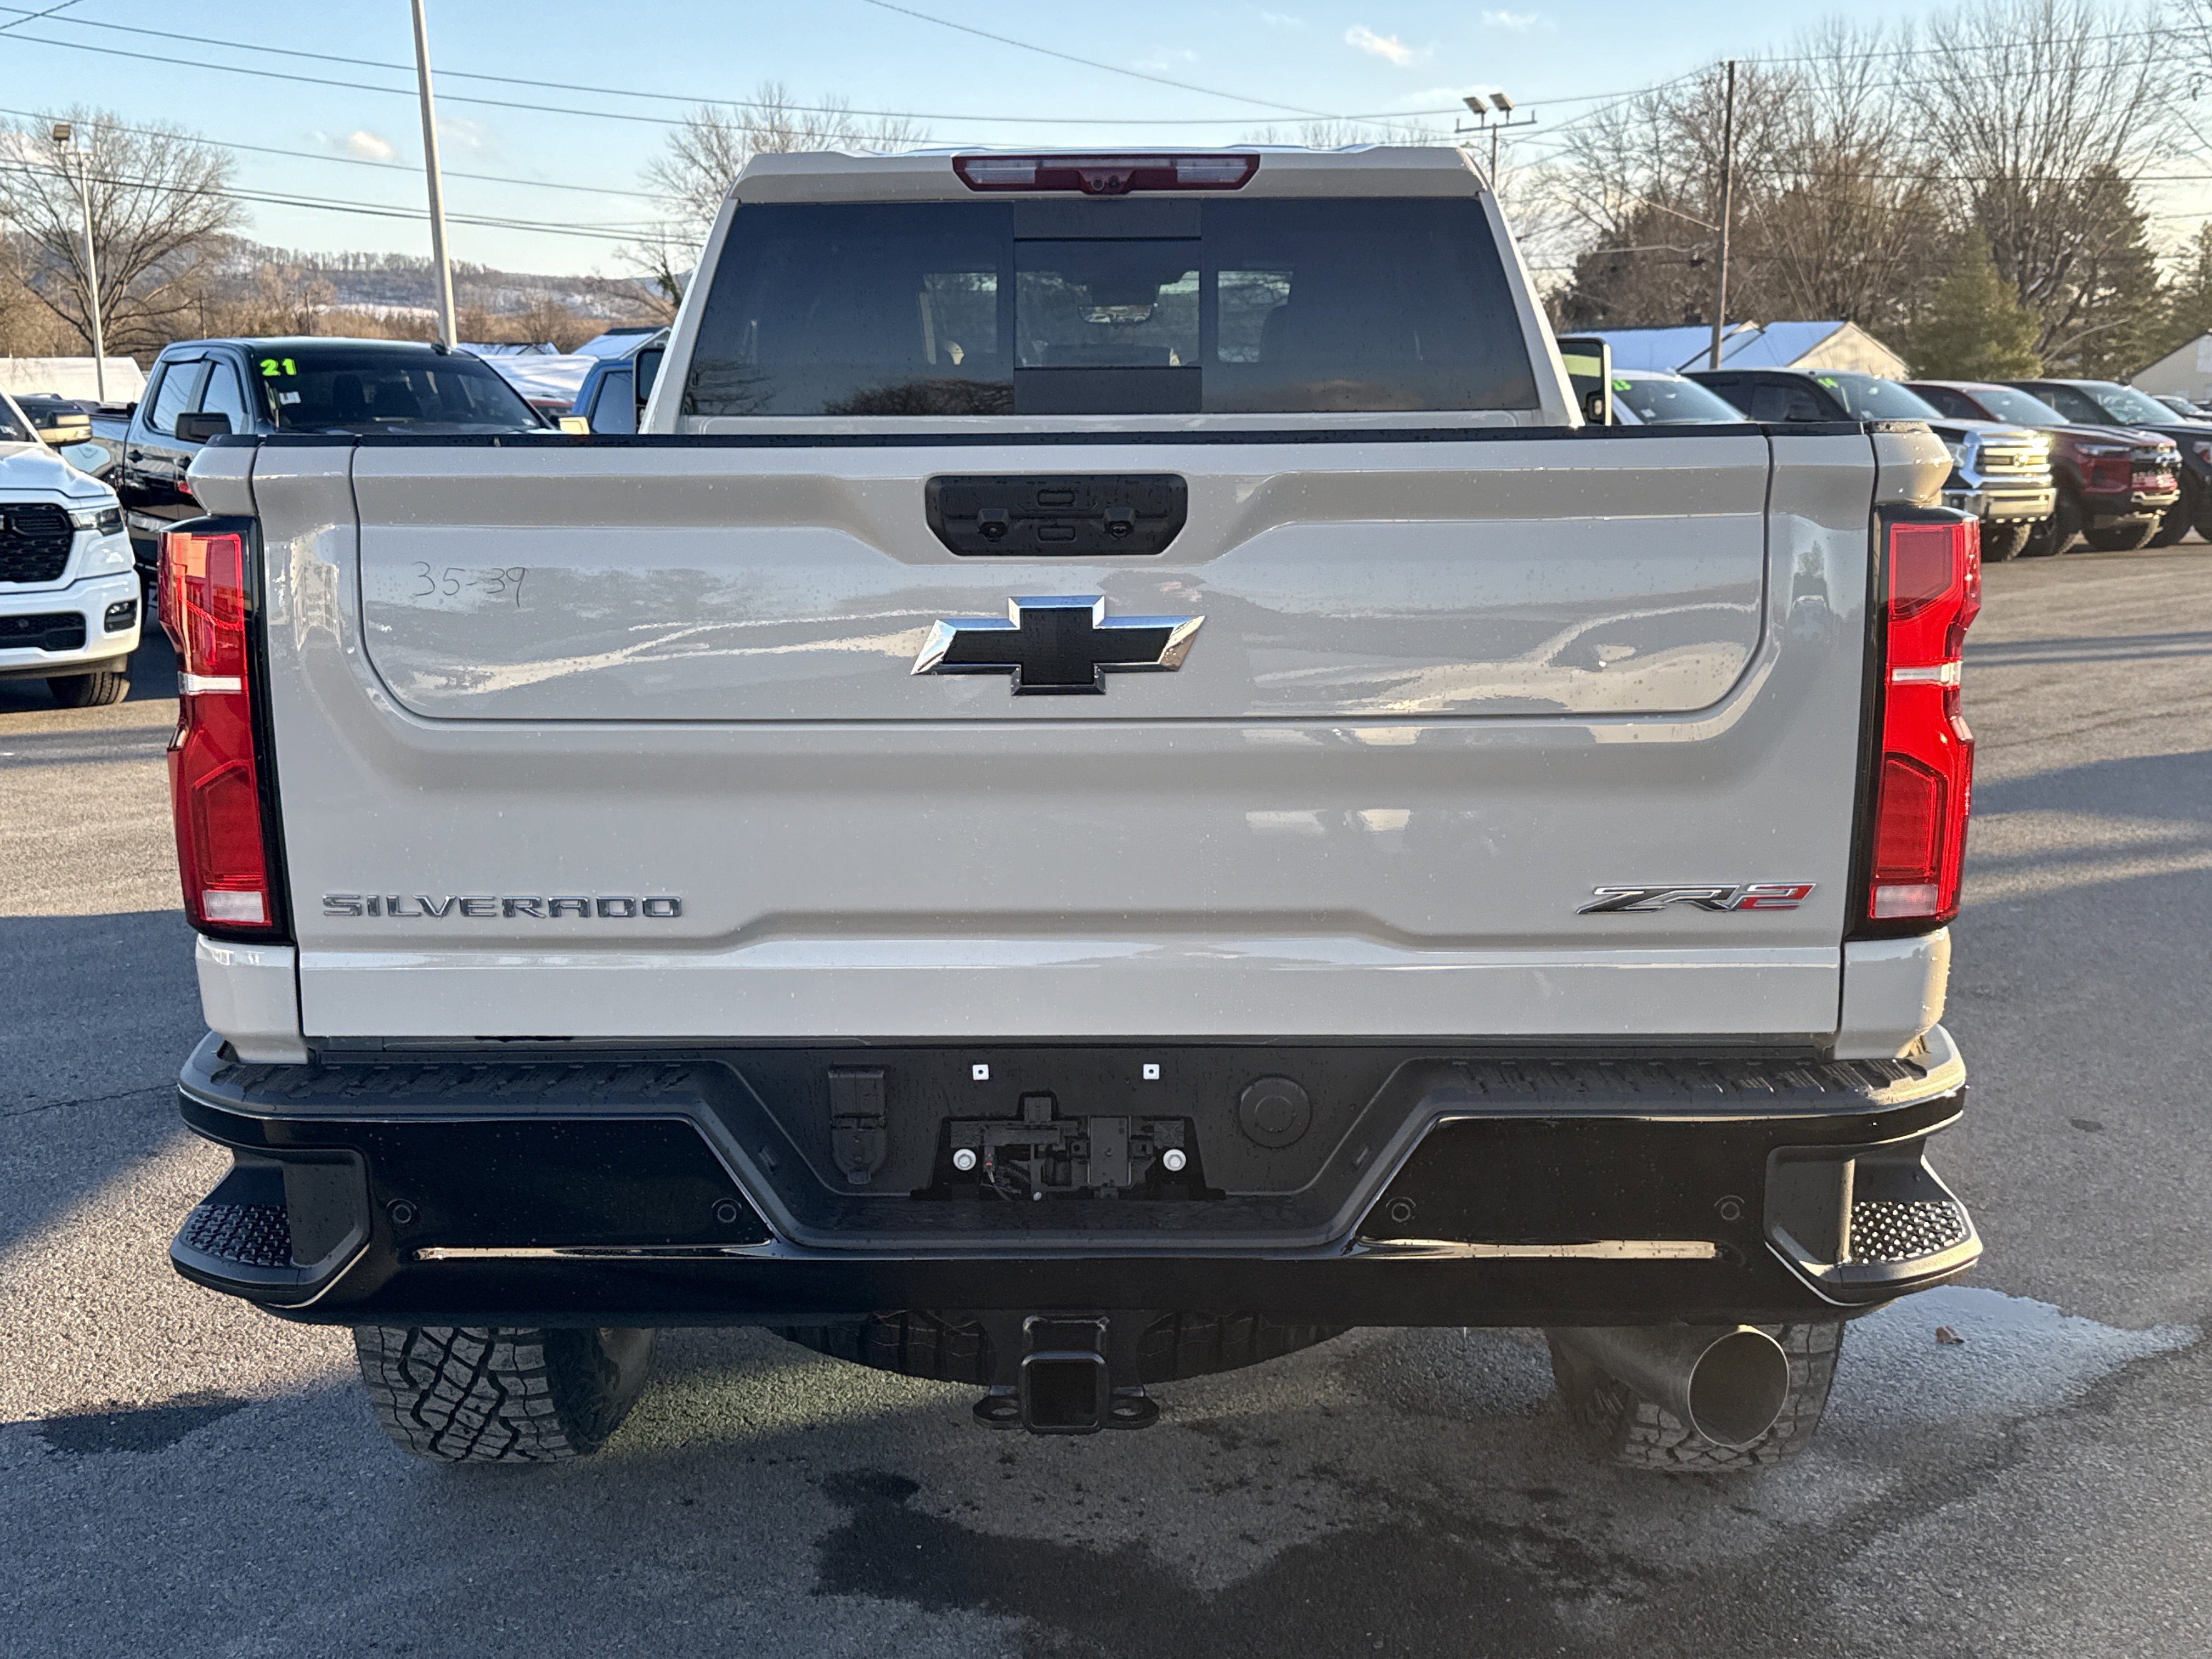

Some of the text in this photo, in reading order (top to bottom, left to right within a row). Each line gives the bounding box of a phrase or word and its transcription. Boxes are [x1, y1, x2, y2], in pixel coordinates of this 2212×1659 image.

[260, 358, 297, 376] 21
[412, 561, 529, 608] 35-39
[322, 893, 682, 919] SILVERADO
[1576, 882, 1816, 915] ZR2
